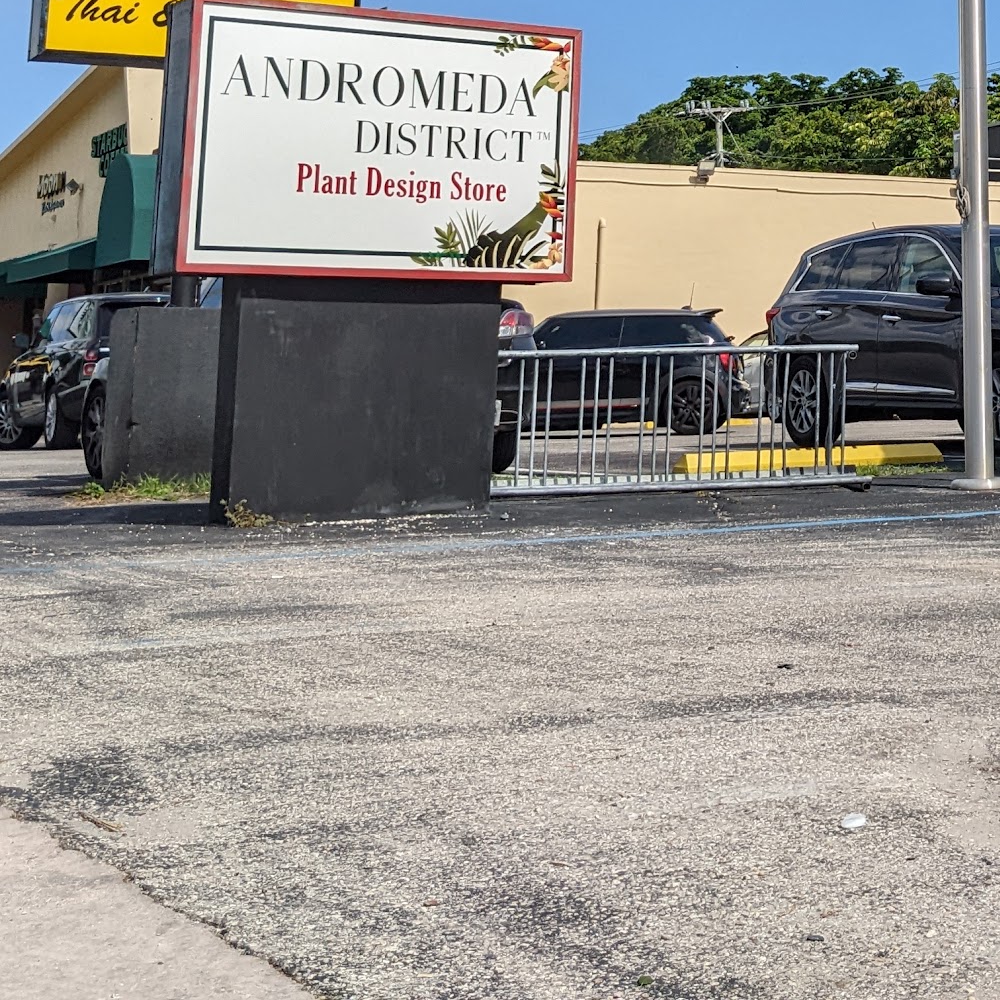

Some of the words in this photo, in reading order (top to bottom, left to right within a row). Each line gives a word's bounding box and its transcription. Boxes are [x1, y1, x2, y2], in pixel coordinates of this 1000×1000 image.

[220, 54, 538, 118] ANDROMEDA
[354, 119, 533, 163] DISTRICT
[296, 162, 358, 196] Plant
[365, 166, 442, 204] Design
[449, 171, 508, 203] Store
